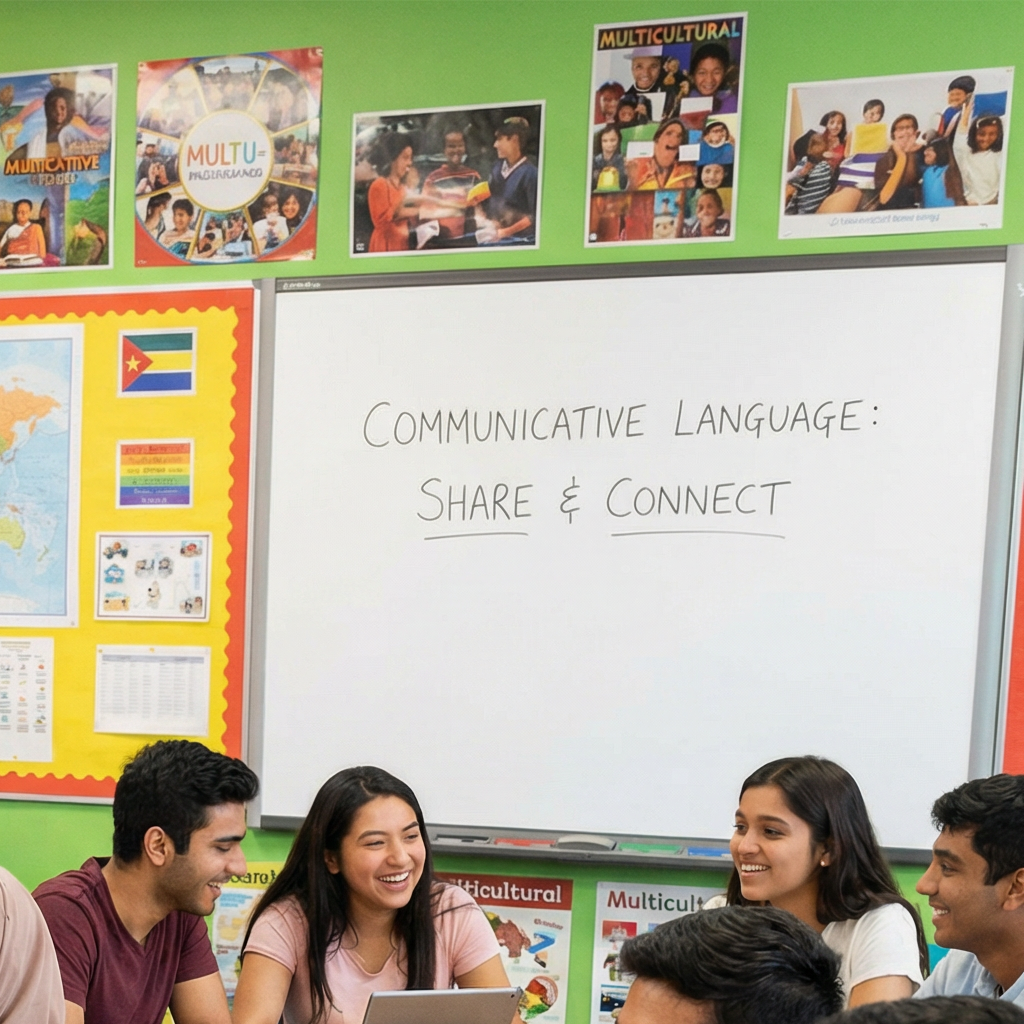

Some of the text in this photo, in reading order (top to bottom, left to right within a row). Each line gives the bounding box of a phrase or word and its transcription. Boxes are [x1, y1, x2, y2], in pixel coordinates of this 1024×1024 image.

[600, 20, 741, 49] MULTICULTURAL
[363, 399, 879, 448] COMMUNICATIVE LANGUAGE:
[417, 475, 792, 525] SHARE & CONNECT
[450, 878, 562, 903] ticultural
